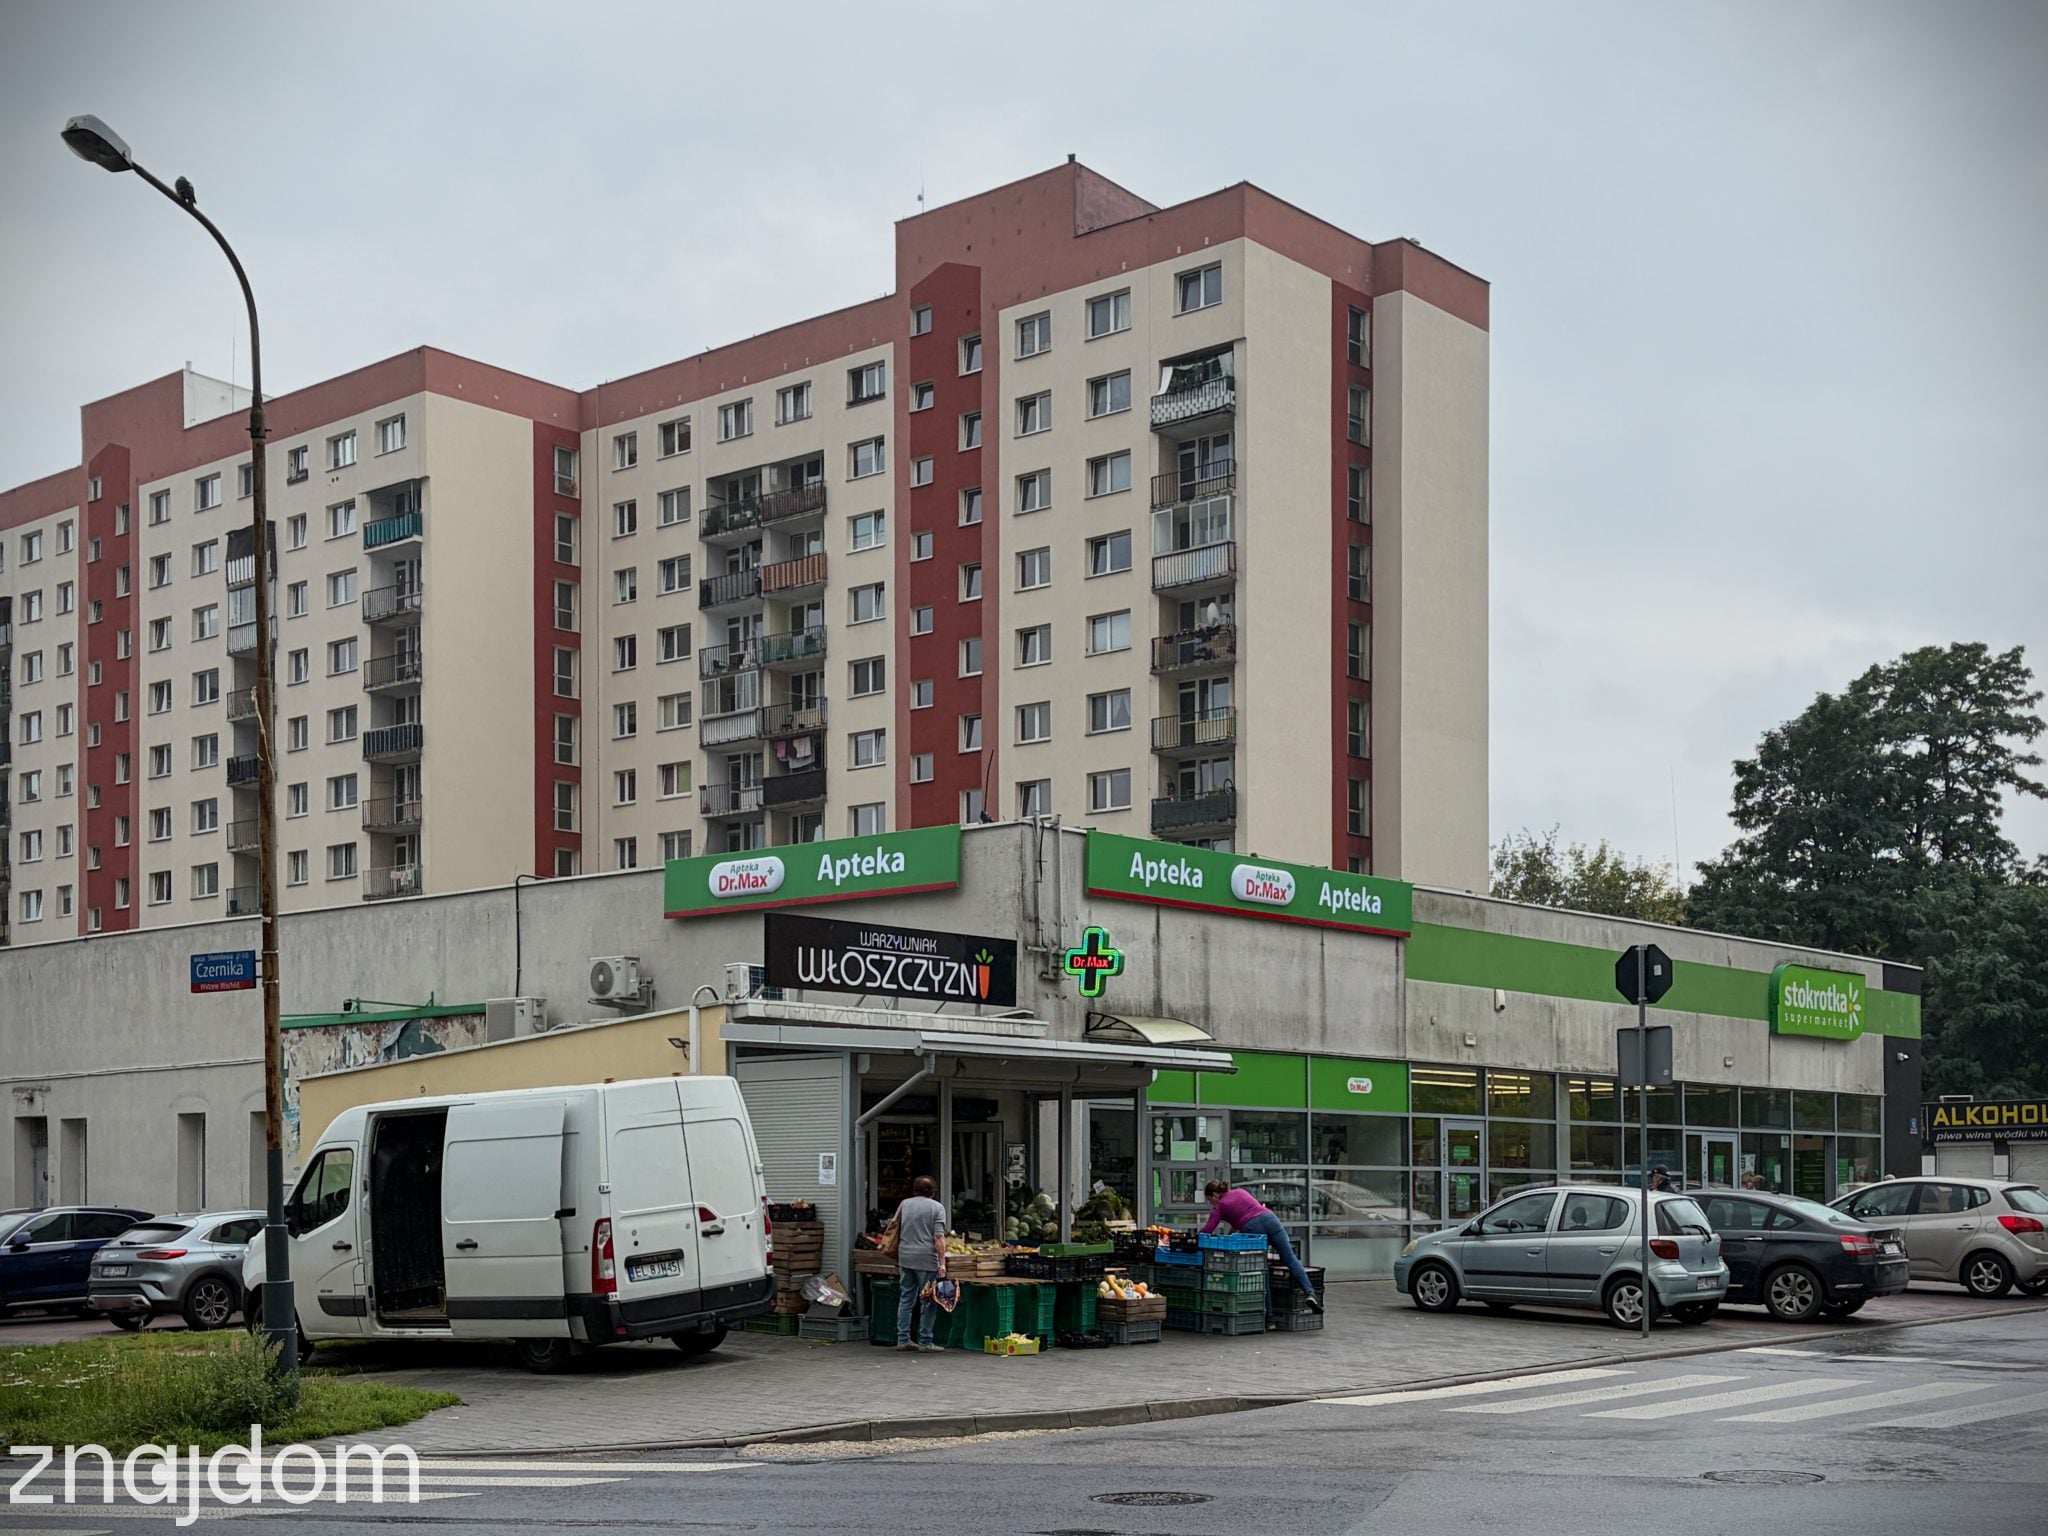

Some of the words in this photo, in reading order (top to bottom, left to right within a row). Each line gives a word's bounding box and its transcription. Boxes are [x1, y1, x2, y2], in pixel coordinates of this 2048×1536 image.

[730, 862, 759, 875] Apteka
[817, 846, 905, 887] Apteka
[1129, 851, 1203, 888] Apteka
[1256, 870, 1280, 882] Apteka
[1319, 881, 1382, 914] Apteka
[859, 931, 937, 954] WARZYWNIAK
[196, 960, 244, 978] Czernika
[1784, 979, 1848, 1014] stokrotka
[1784, 1012, 1848, 1028] supermarket
[1936, 1132, 1962, 1141] piwa
[1965, 1131, 1991, 1139] wina
[1995, 1129, 2028, 1139] wódki
[635, 1266, 648, 1277] EL
